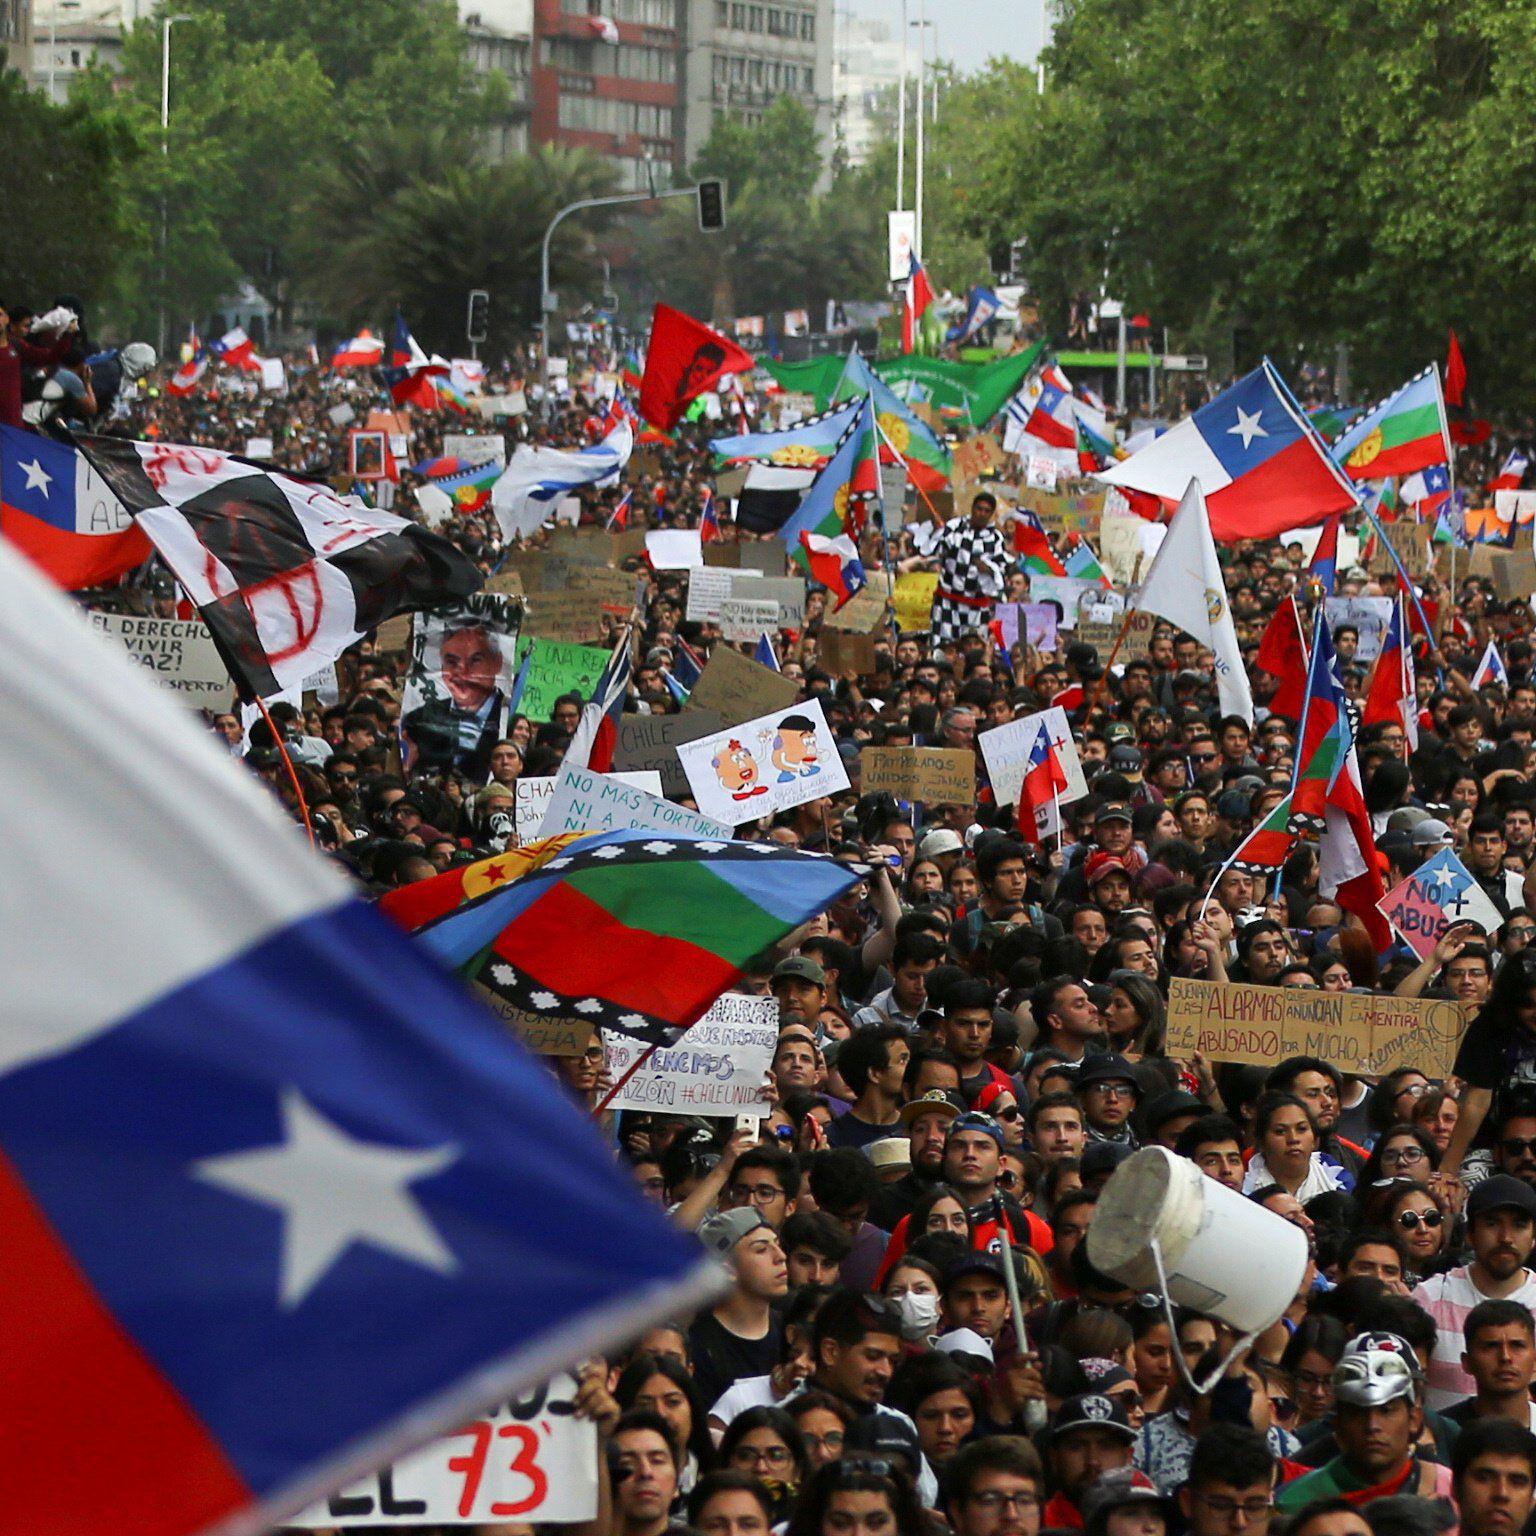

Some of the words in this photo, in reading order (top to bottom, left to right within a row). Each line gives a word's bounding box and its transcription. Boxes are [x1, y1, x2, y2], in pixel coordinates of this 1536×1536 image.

[120, 618, 213, 641] DERECHO
[124, 638, 183, 654] VIVIR
[620, 722, 676, 751] CHILE
[627, 760, 686, 786] DESPE
[516, 781, 556, 800] CHA
[565, 770, 594, 794] NO
[652, 800, 731, 840] TORTURAS
[568, 798, 594, 819] NI
[1406, 878, 1443, 905] NO
[1174, 1001, 1203, 1015] LAS
[1285, 995, 1343, 1026] ANUNCIAN
[1207, 986, 1284, 1022] ALARMAS
[1363, 1011, 1419, 1028] MENTIRA
[1305, 1030, 1359, 1060] MUCHO
[636, 1048, 735, 1081] TENEMOS
